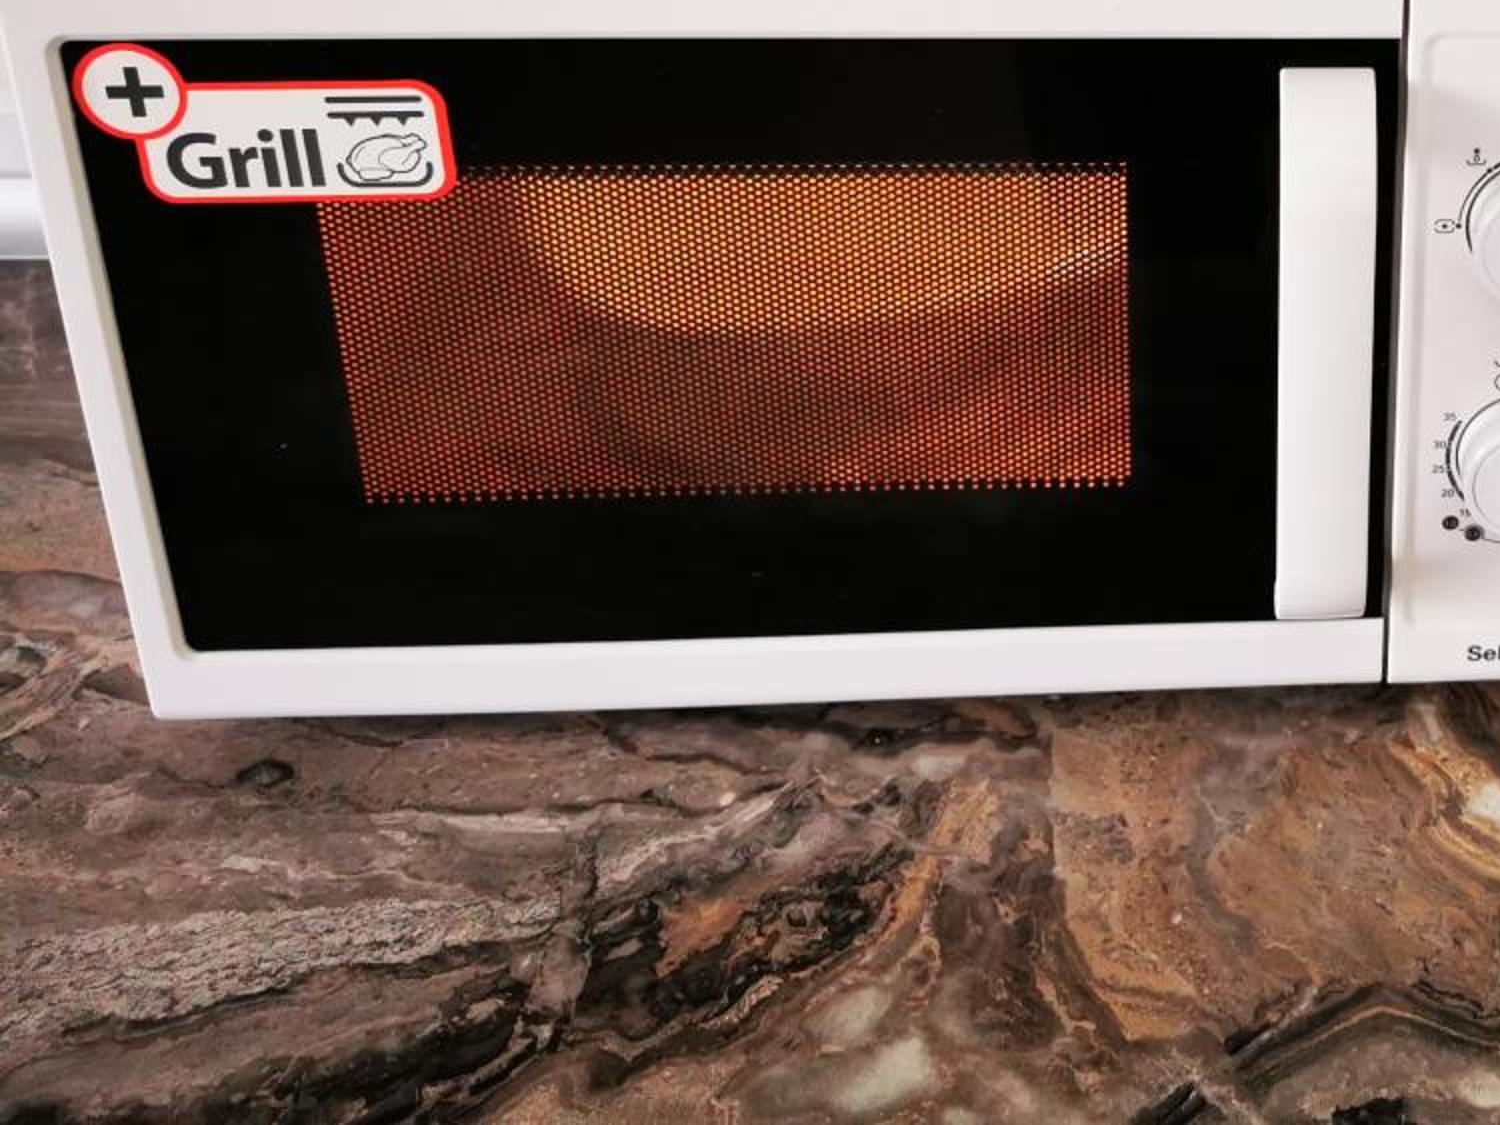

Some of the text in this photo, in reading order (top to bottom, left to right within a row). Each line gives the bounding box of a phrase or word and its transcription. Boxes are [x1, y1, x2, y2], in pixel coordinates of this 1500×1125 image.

[166, 128, 327, 189] Grill
[1431, 464, 1445, 474] 25
[1441, 489, 1455, 499] 20
